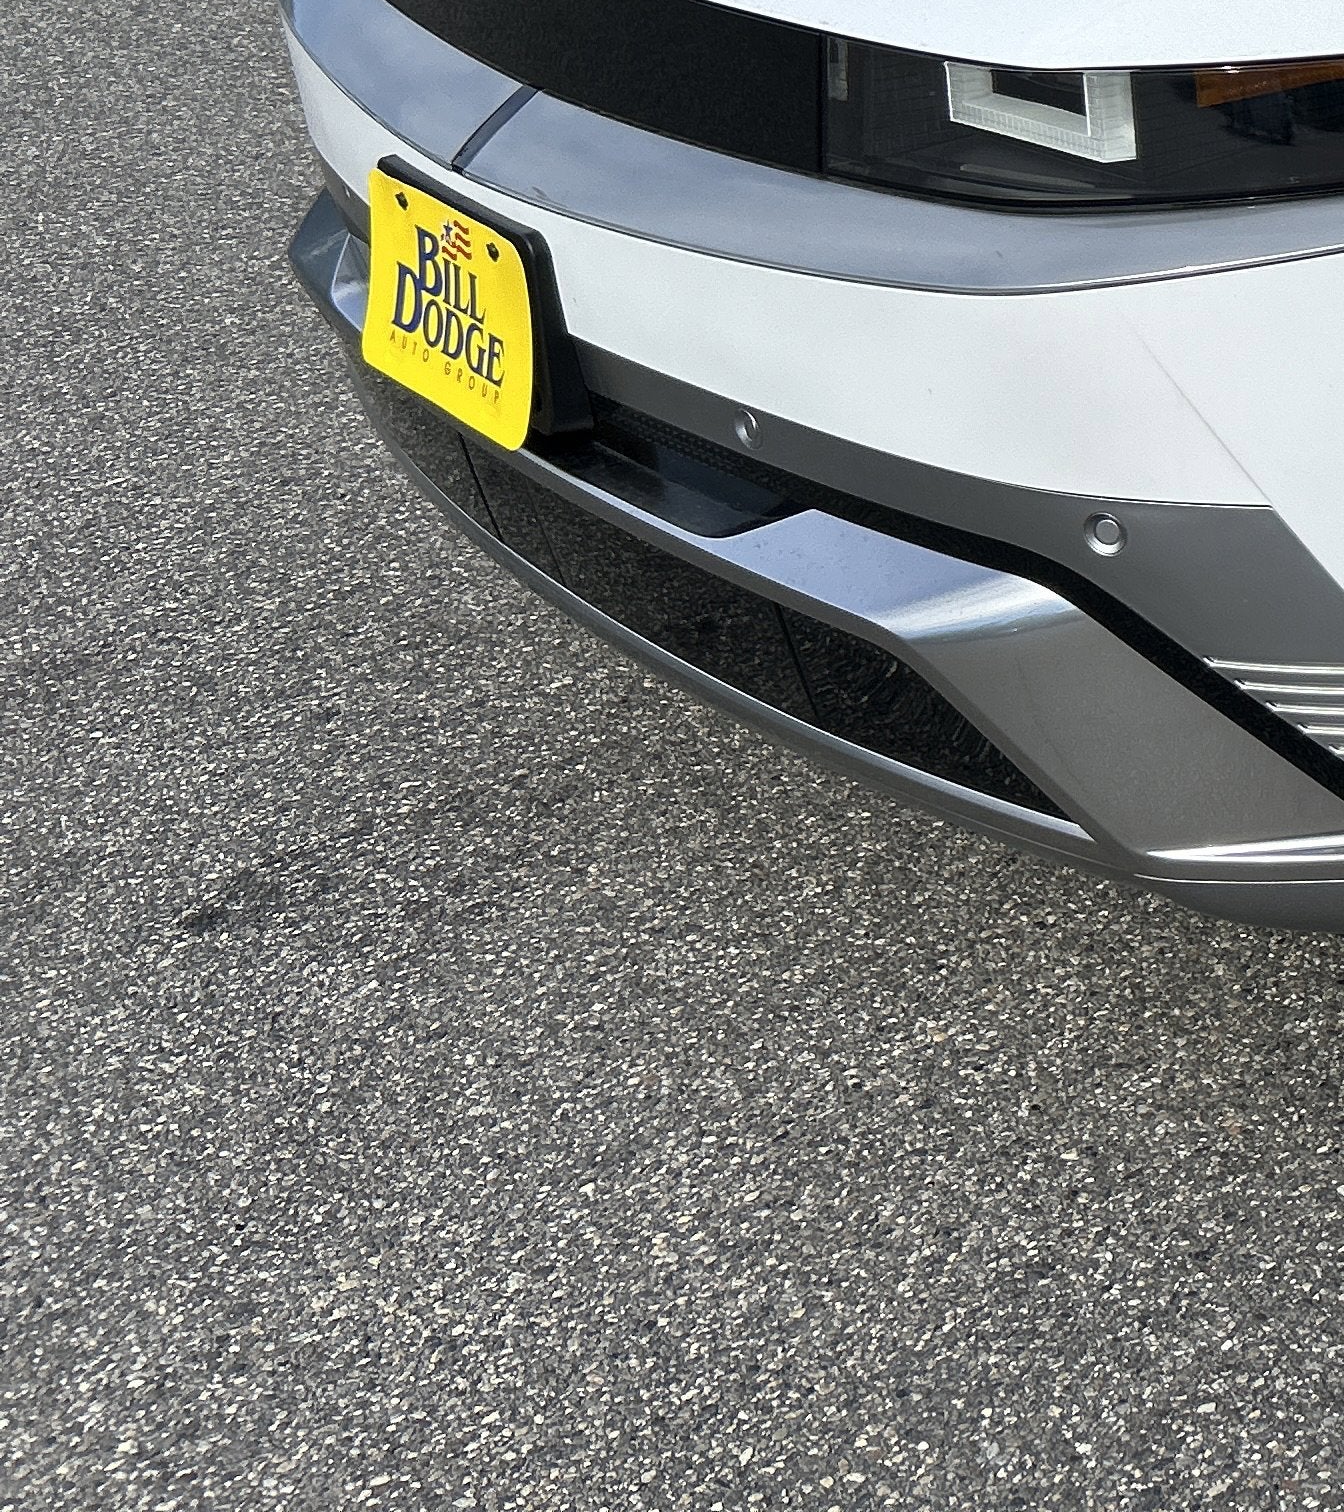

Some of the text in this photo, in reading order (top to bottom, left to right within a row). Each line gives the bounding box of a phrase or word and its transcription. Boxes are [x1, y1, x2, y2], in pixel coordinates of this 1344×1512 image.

[414, 225, 486, 324] BILL
[389, 332, 500, 403] AUTO GROUP
[392, 262, 505, 387] DODGE
